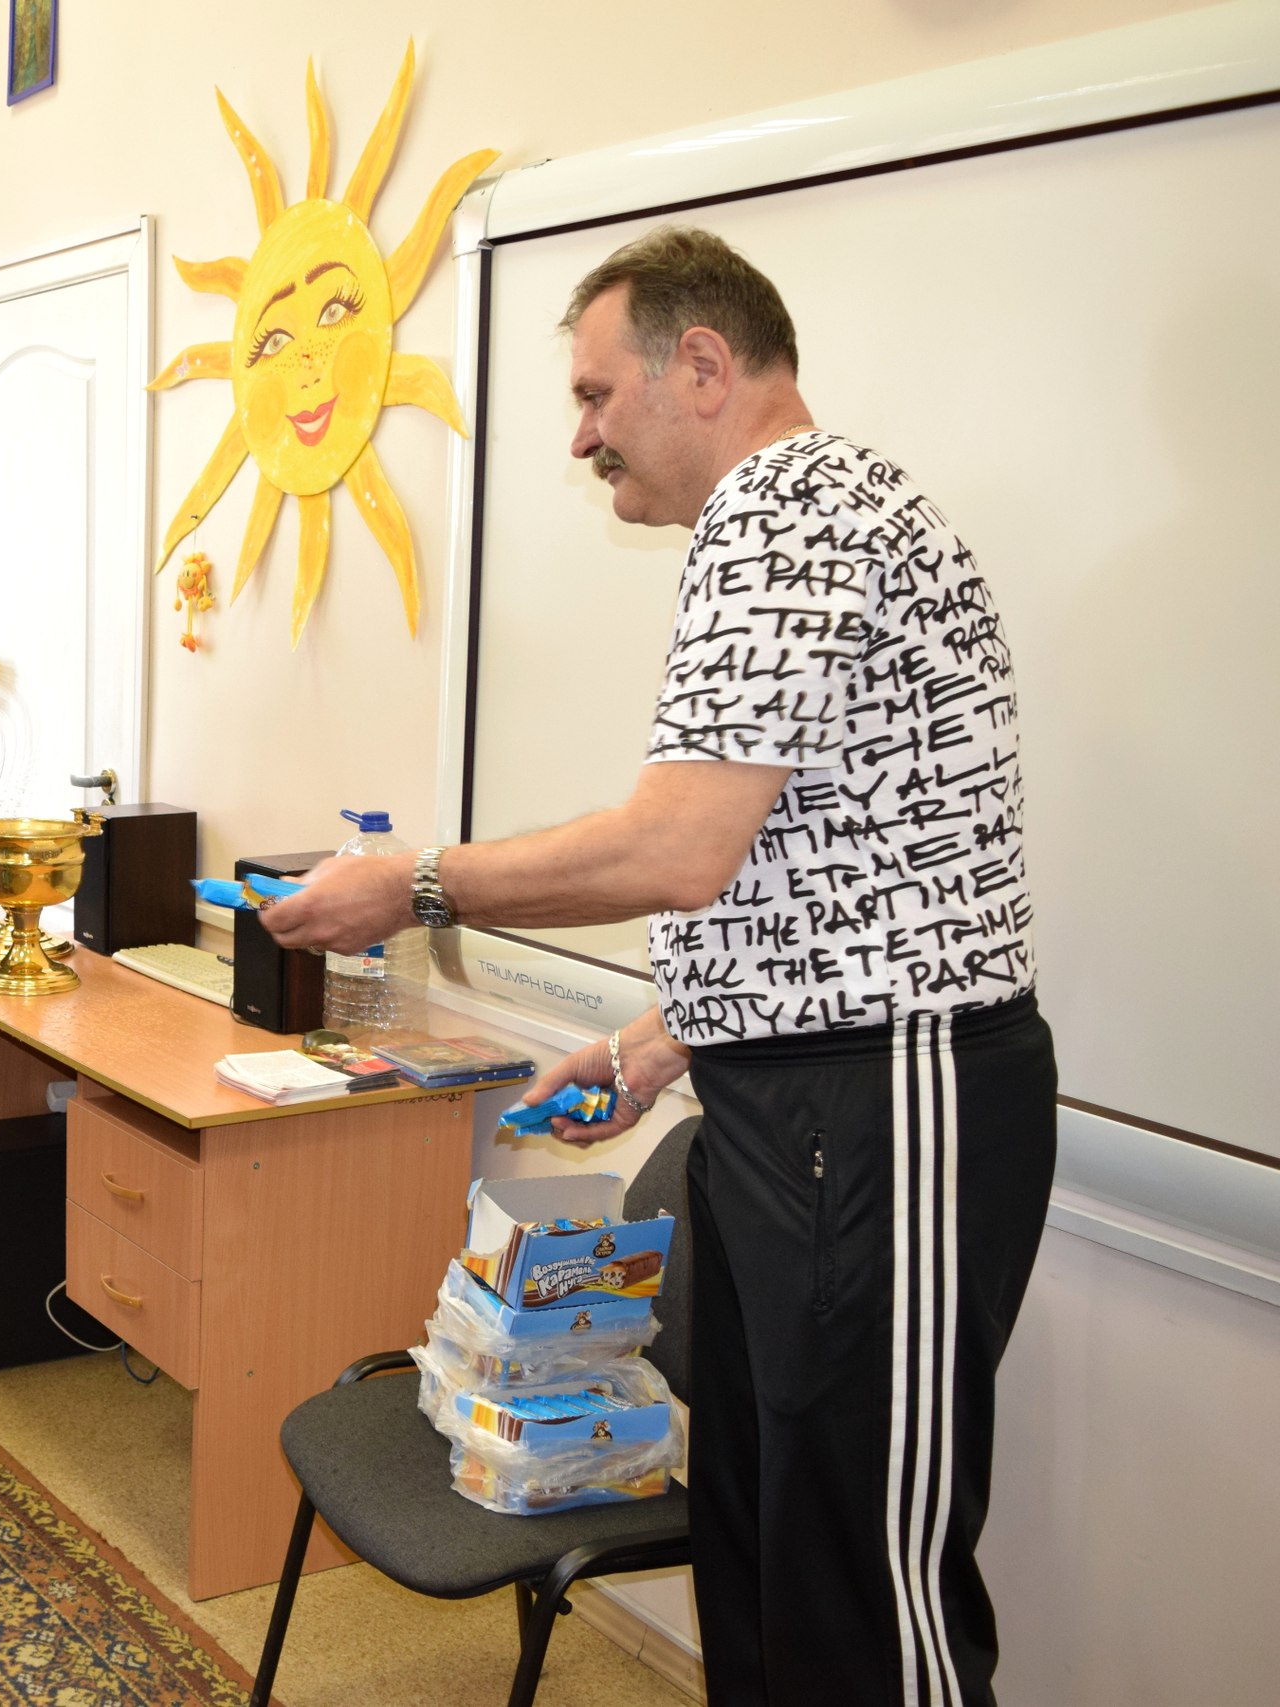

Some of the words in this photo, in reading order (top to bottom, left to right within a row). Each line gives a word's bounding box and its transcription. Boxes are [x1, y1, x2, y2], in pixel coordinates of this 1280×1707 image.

[748, 607, 863, 641] THE
[702, 643, 805, 682] ALL
[753, 688, 840, 725] ALL
[842, 713, 974, 776] THE
[661, 919, 705, 957] THE
[708, 912, 801, 954] TIME
[478, 959, 541, 991] TRIUMPH
[682, 957, 745, 991] ALL
[756, 947, 844, 987] THE
[906, 939, 1029, 998] PARTY
